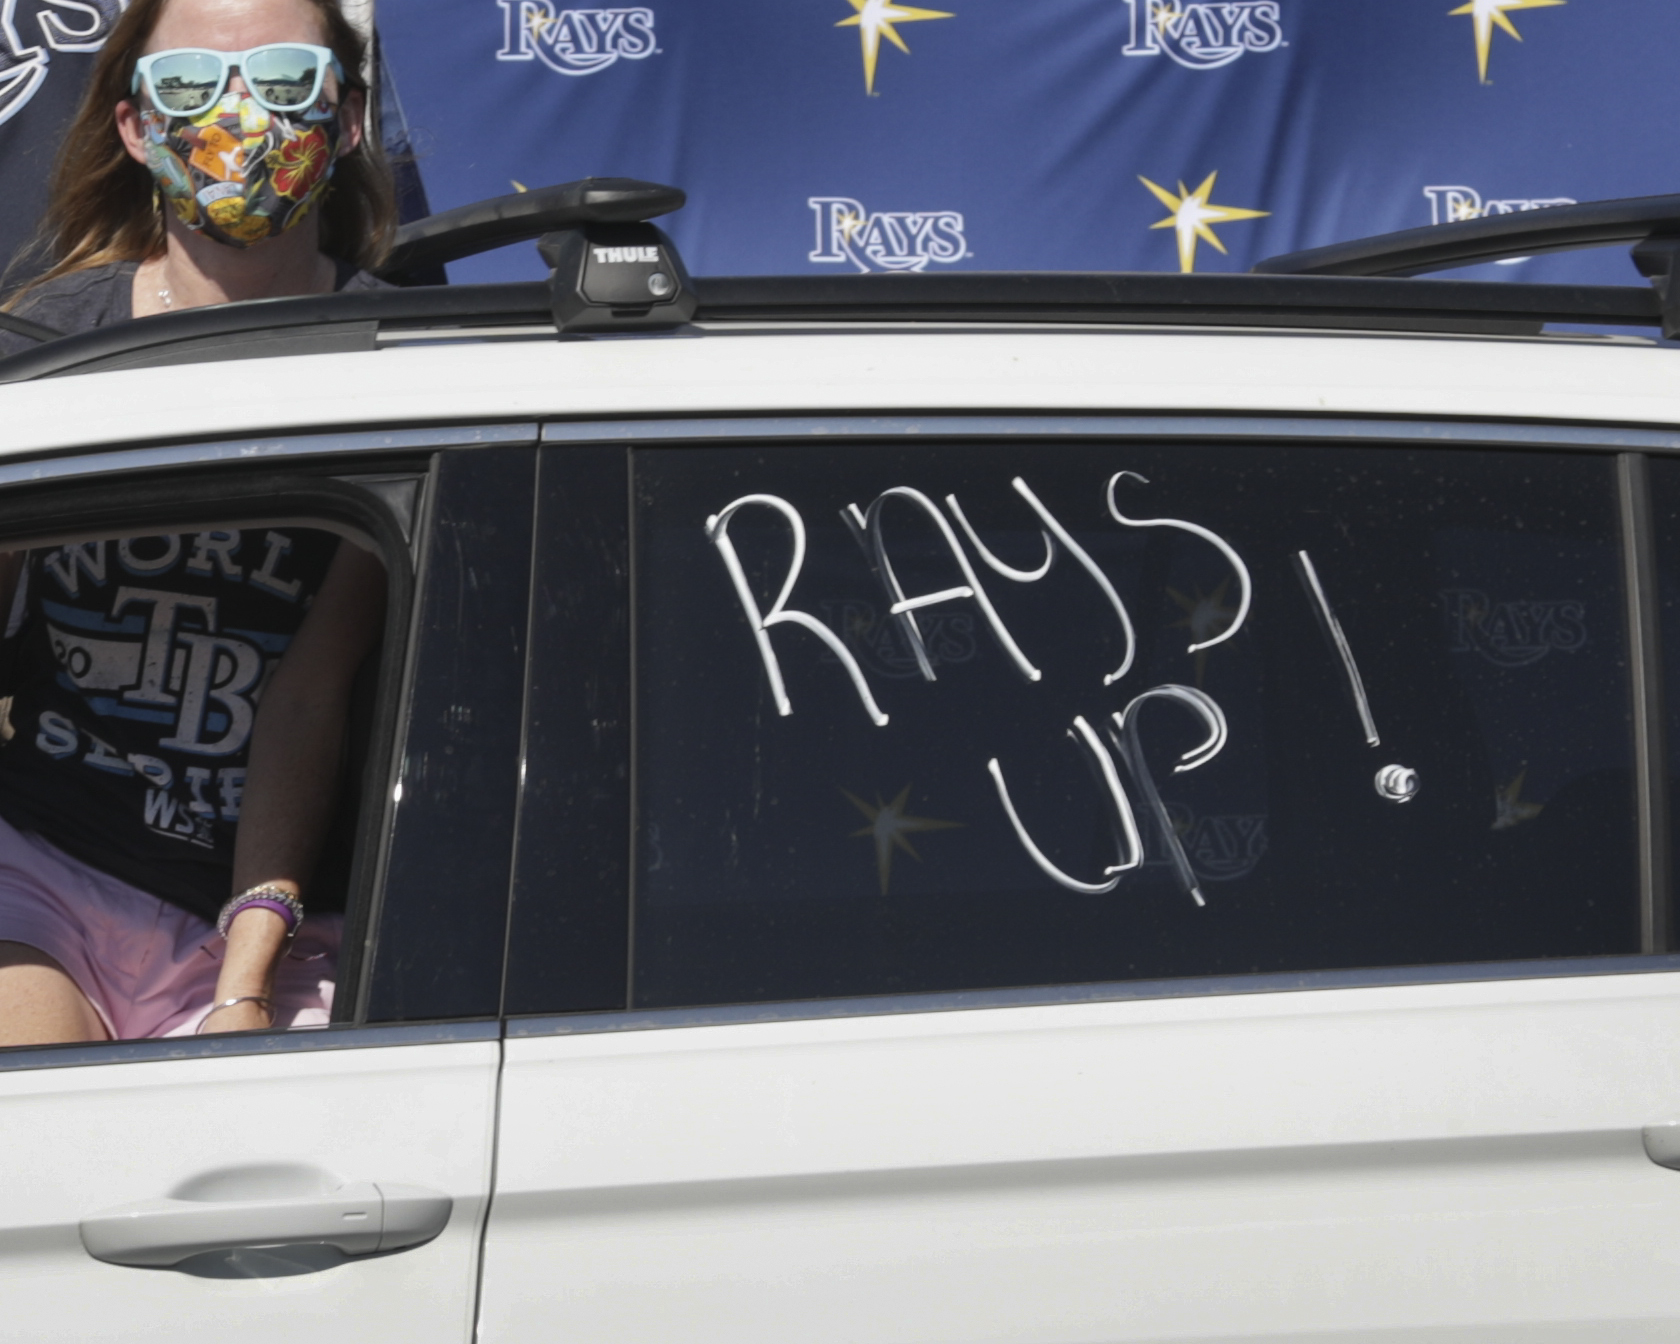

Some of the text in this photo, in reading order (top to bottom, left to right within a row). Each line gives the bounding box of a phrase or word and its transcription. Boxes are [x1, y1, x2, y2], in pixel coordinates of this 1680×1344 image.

[593, 246, 659, 264] THULE
[809, 197, 966, 273] RAYS
[43, 530, 312, 605] WORL
[704, 471, 1251, 727] RAYS
[1444, 588, 1586, 667] RAYS
[111, 586, 263, 758] TB
